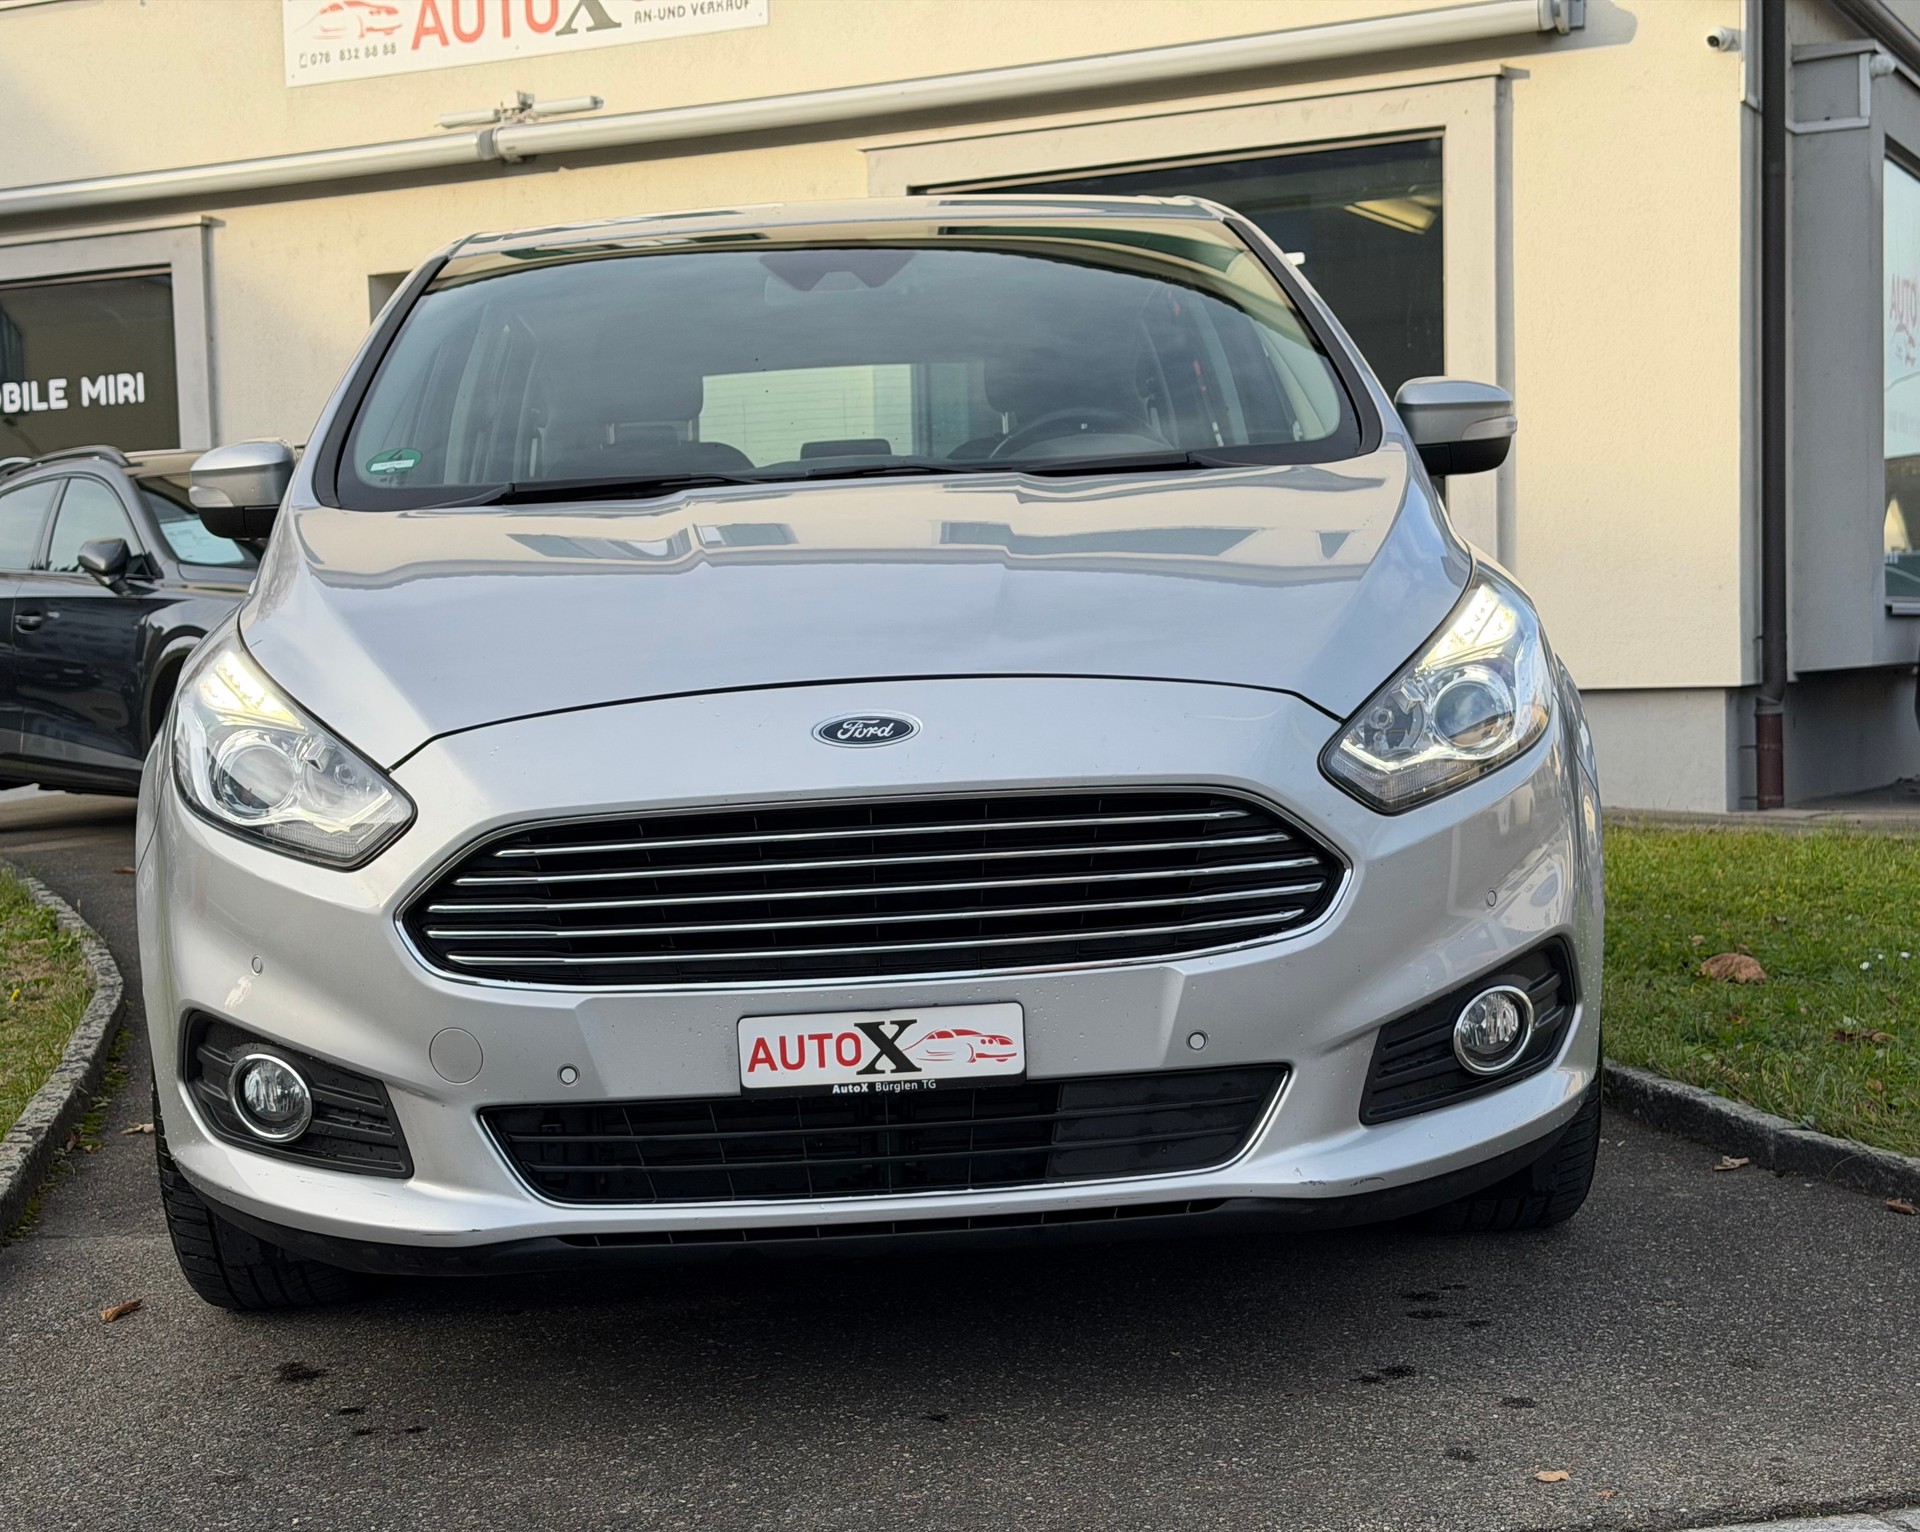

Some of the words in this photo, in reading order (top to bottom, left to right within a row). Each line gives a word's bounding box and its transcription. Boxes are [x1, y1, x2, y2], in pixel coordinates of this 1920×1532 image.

[0, 378, 68, 413] BILE
[81, 372, 145, 407] MIRI
[837, 719, 895, 739] Ford
[832, 1083, 869, 1094] AutoX
[875, 1081, 918, 1093] Bürglen
[922, 1079, 937, 1089] TG
